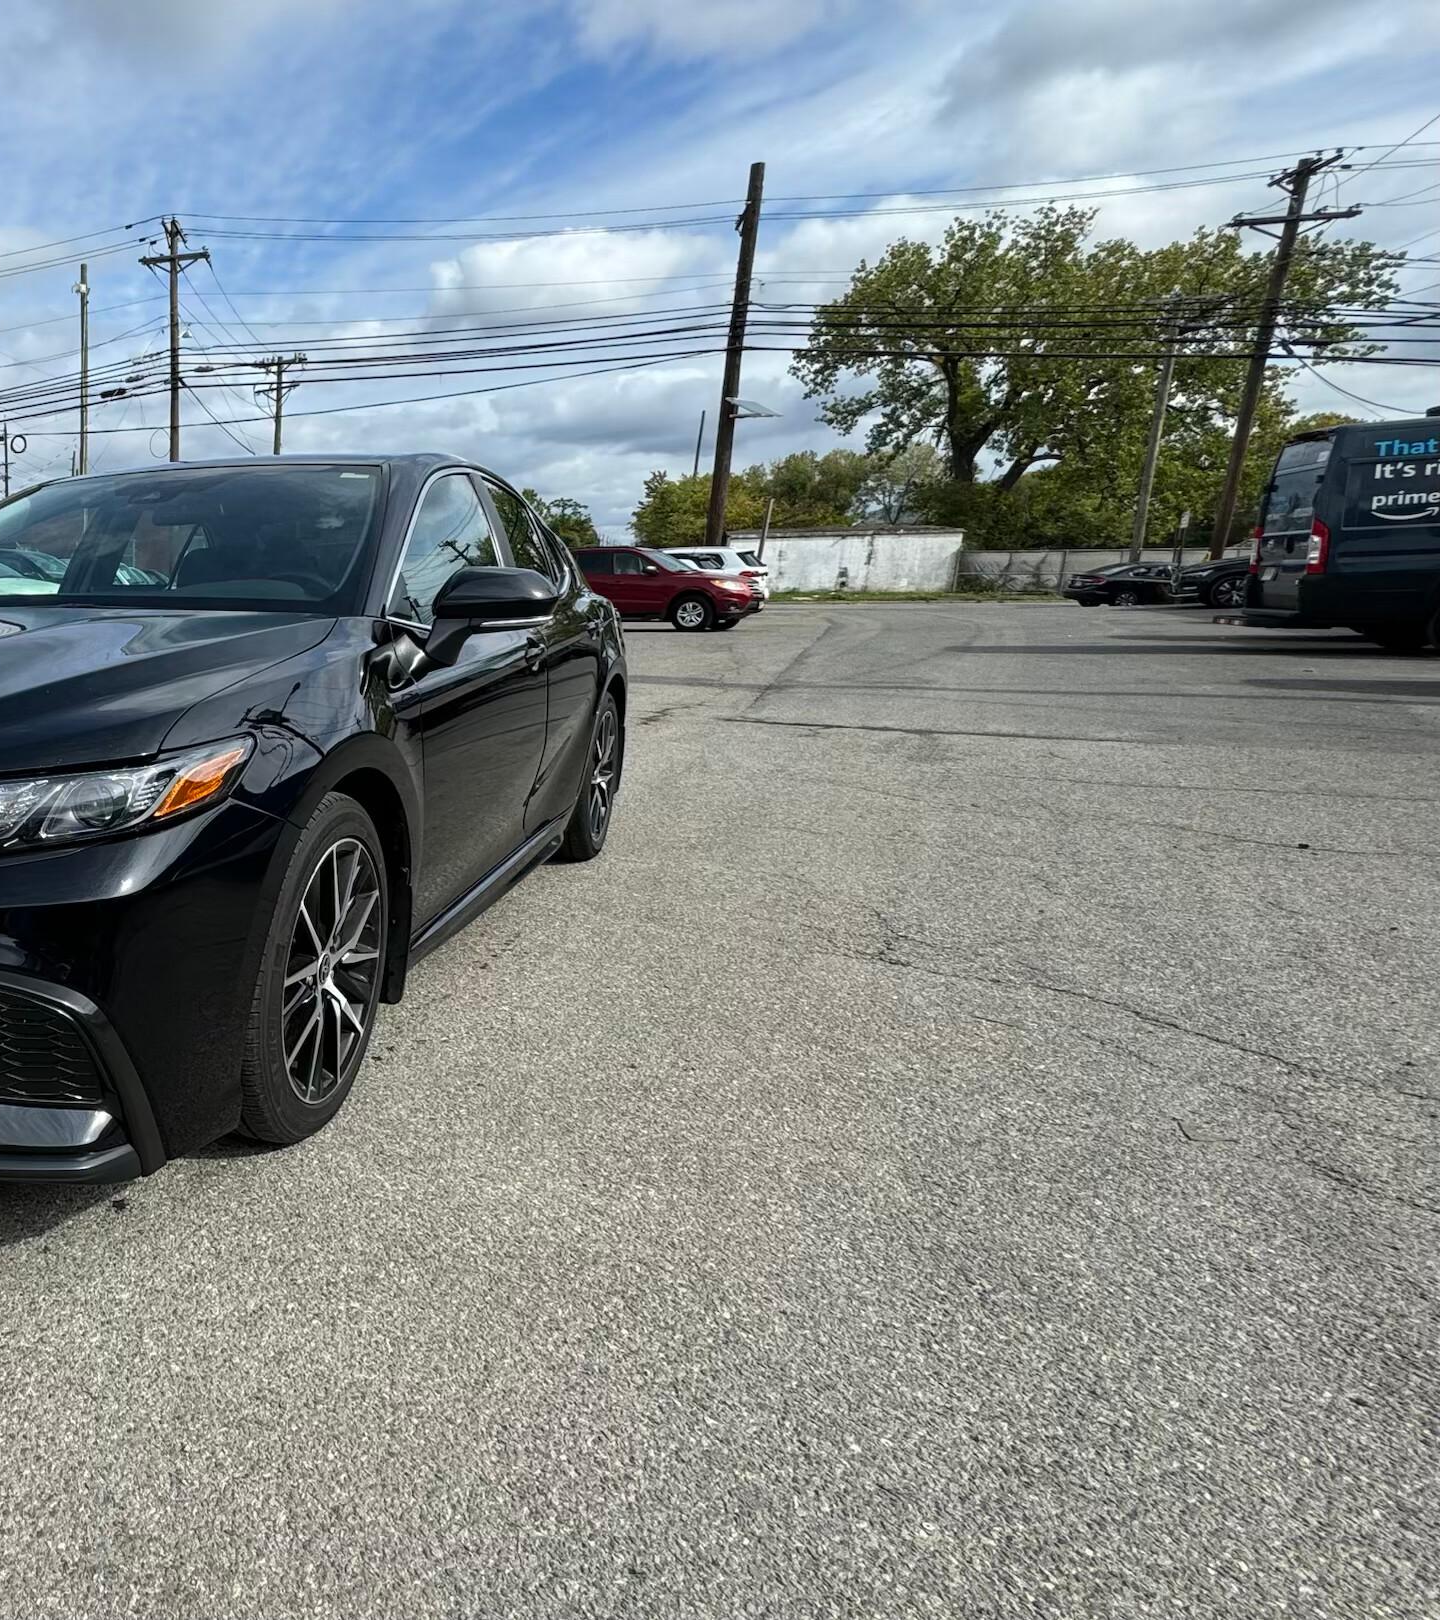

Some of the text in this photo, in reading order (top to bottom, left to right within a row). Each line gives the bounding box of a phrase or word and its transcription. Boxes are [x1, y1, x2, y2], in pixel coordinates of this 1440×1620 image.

[1374, 439, 1439, 457] That
[1374, 462, 1416, 479] It's
[1371, 490, 1440, 510] prime
